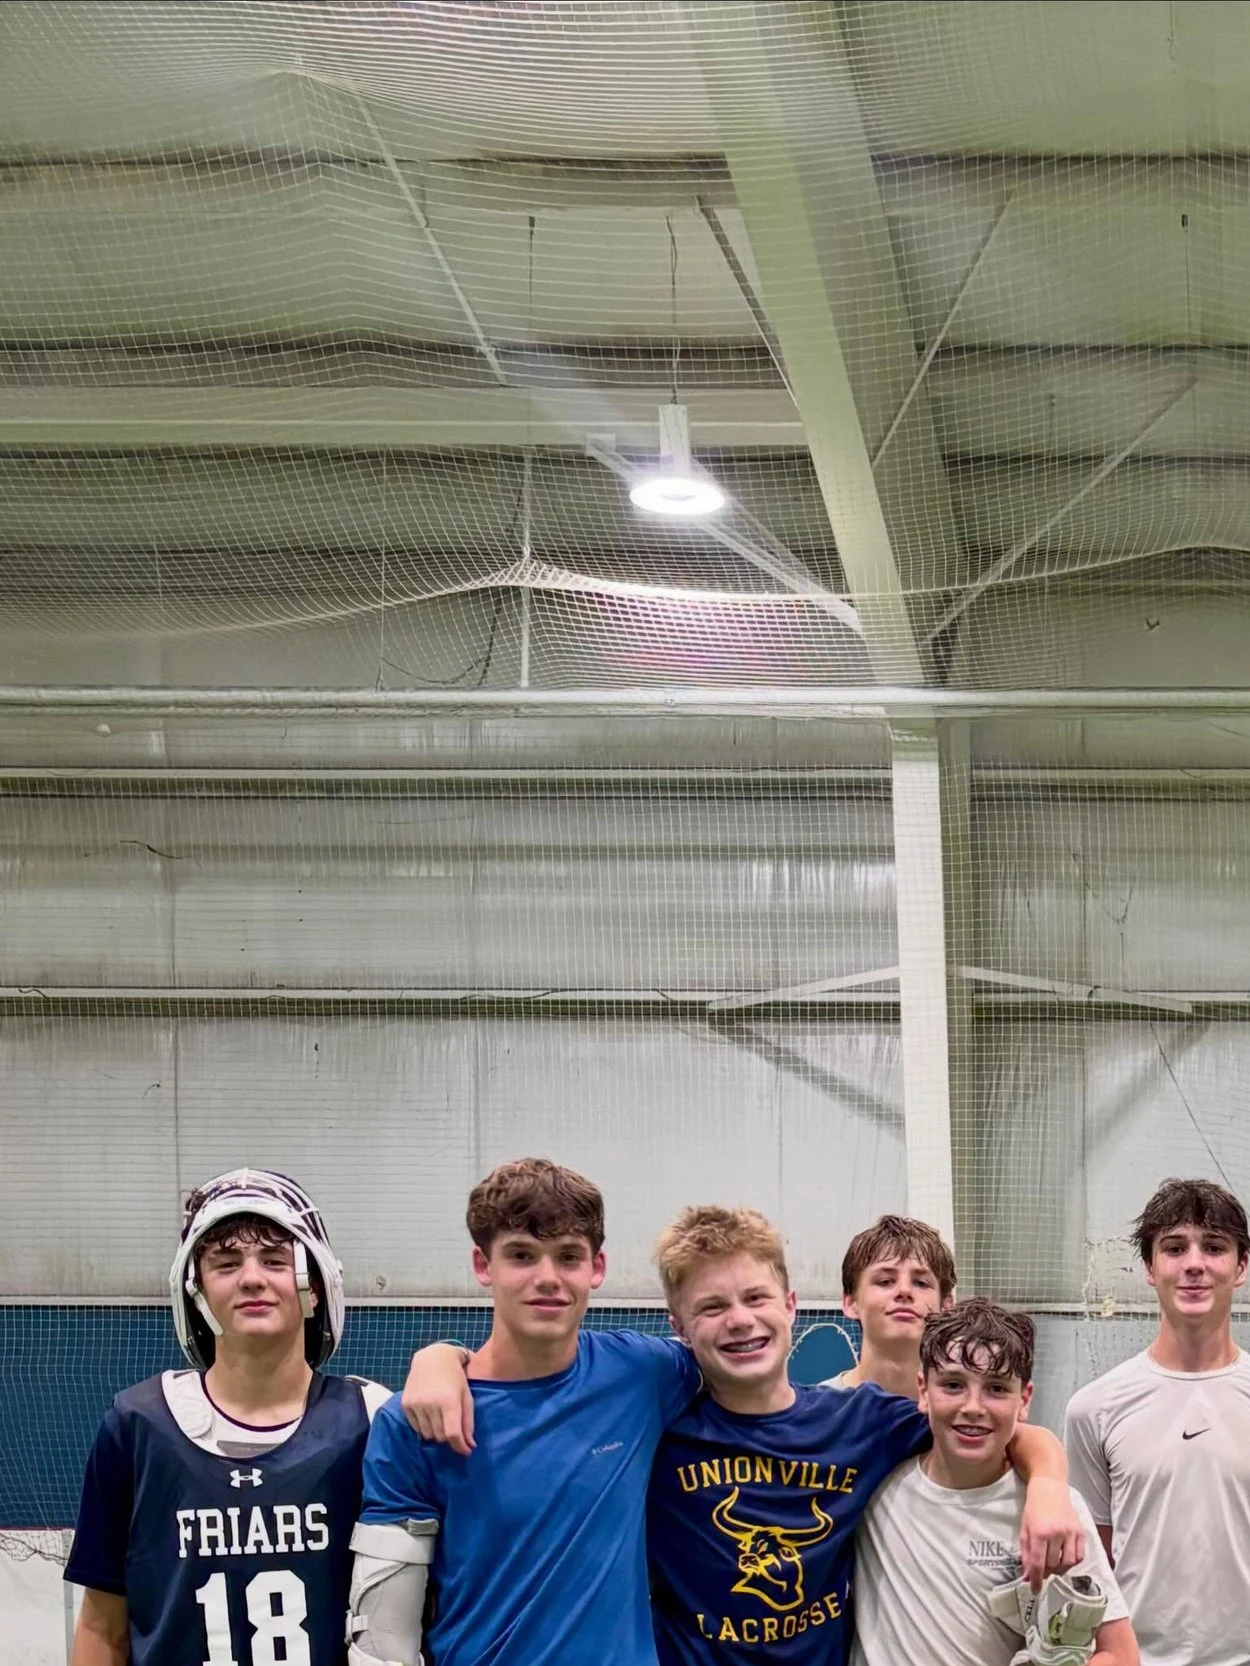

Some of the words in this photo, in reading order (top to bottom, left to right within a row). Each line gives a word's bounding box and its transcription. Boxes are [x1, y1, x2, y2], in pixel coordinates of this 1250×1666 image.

[677, 1456, 858, 1494] UNIONVILLE
[176, 1503, 330, 1558] FRIARS
[969, 1540, 1004, 1557] NIKE
[696, 1592, 842, 1644] LACROSSE
